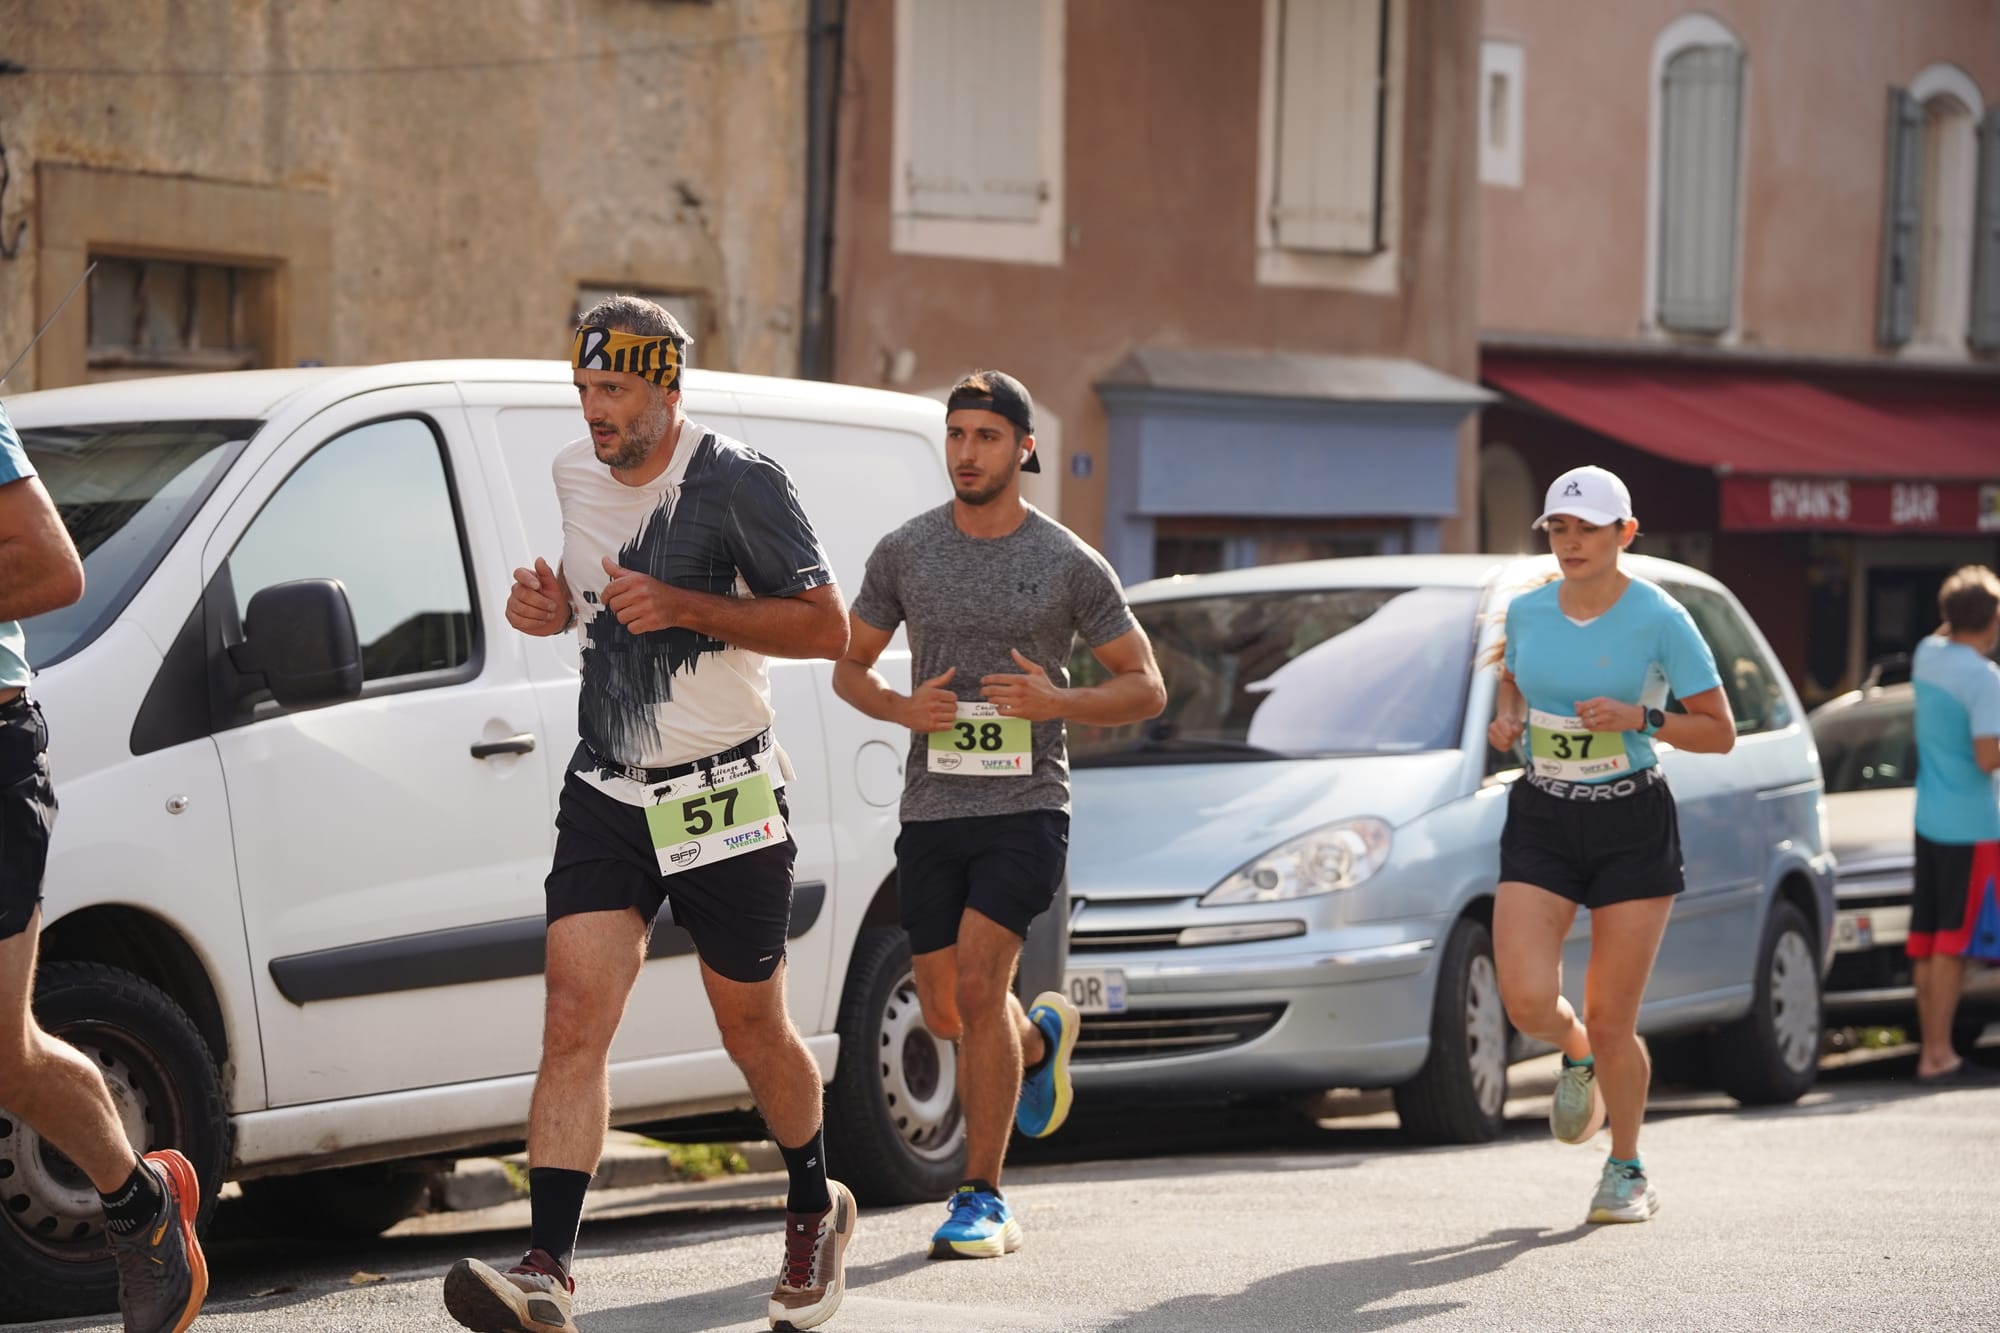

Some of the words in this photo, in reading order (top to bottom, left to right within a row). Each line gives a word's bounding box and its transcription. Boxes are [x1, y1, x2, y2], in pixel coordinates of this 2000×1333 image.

[1891, 484, 1939, 523] BAR
[954, 722, 1003, 751] 38
[1551, 734, 1594, 759] 37
[1569, 780, 1636, 800] PRO
[682, 788, 739, 836] 57
[723, 829, 761, 846] TUFF'S
[729, 835, 767, 851] Aventure
[670, 849, 698, 862] BFP
